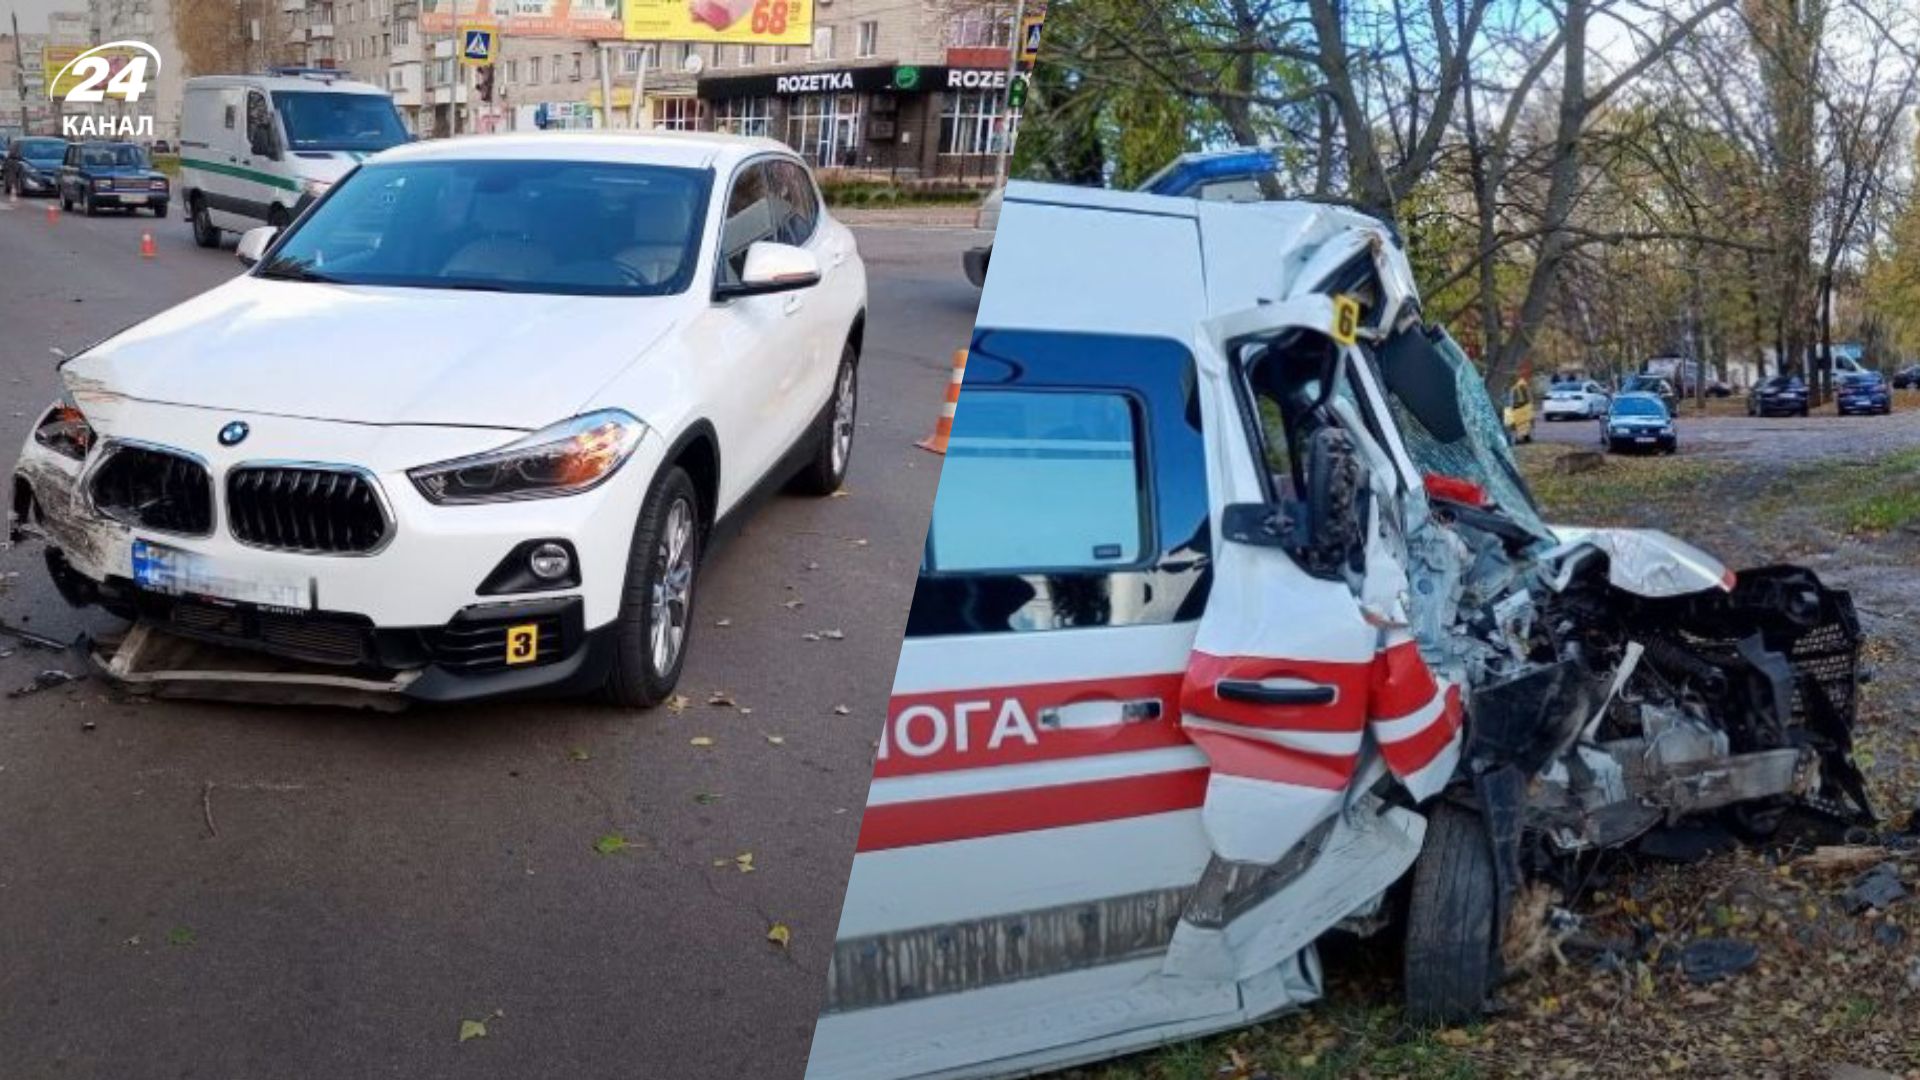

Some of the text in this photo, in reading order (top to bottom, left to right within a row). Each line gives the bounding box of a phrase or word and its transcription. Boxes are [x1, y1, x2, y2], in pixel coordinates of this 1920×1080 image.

[752, 0, 787, 34] 68
[776, 72, 853, 93] ROZETKA
[1339, 303, 1354, 338] 6
[513, 632, 532, 657] 3
[877, 697, 1038, 760] ОГА
